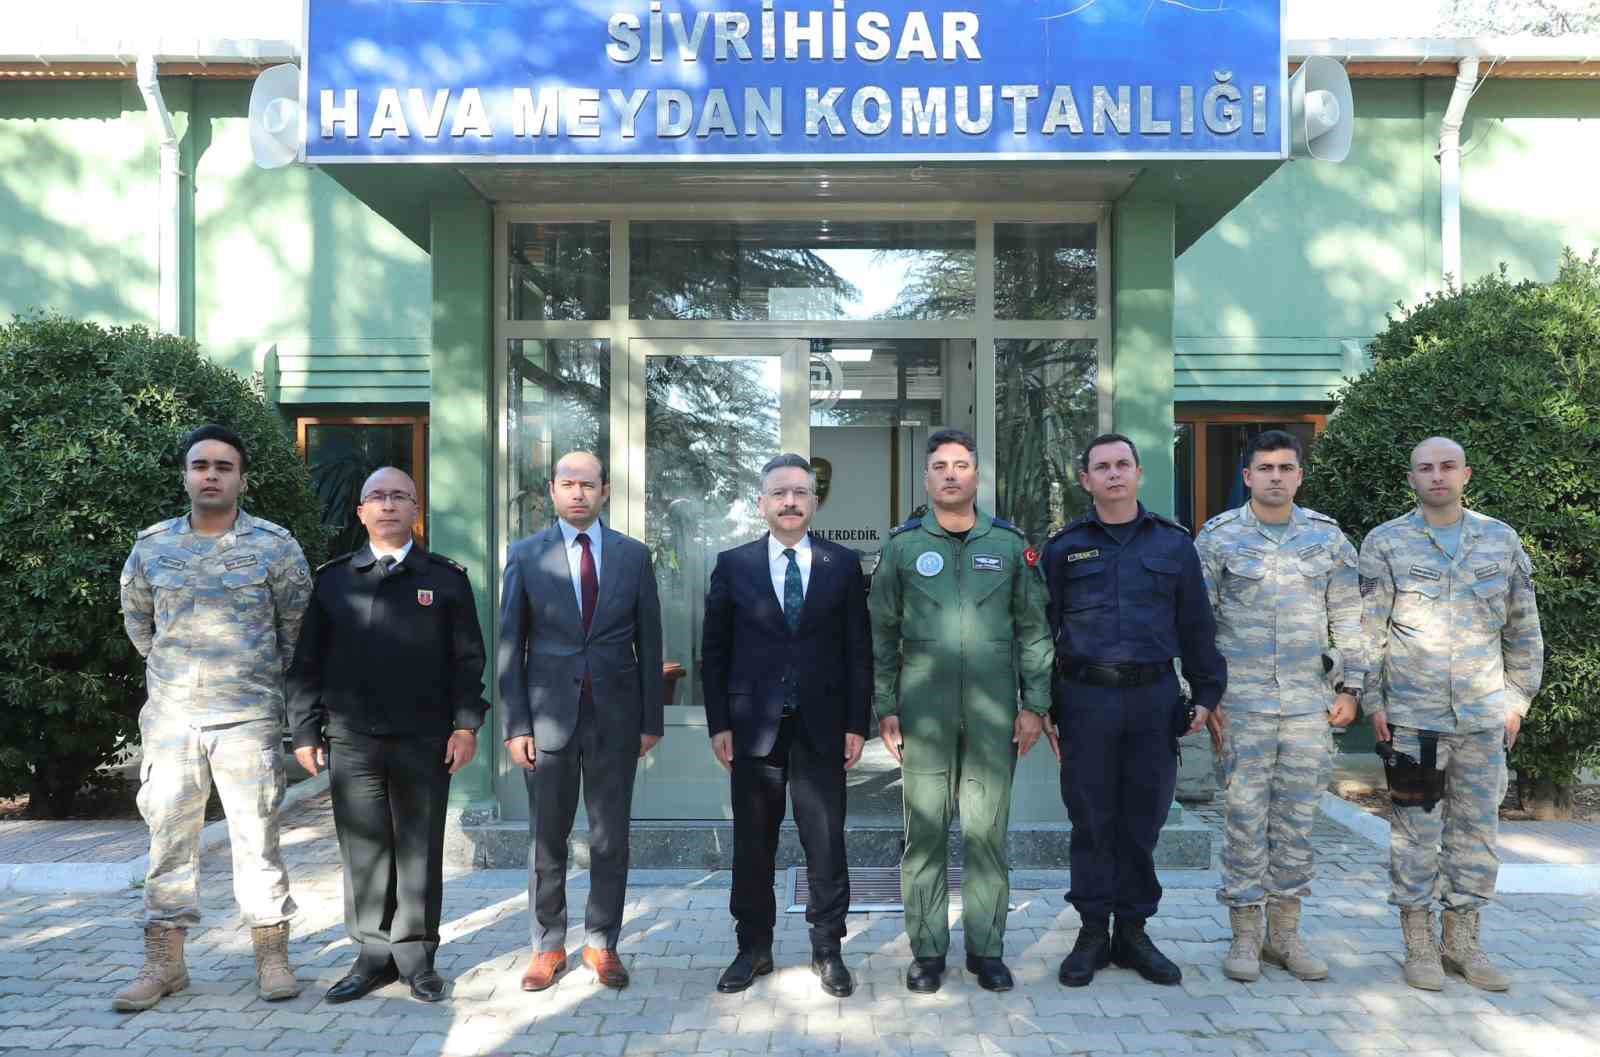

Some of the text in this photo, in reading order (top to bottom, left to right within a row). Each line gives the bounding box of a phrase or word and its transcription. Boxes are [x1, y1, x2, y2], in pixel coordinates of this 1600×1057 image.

[606, 0, 982, 61] SİVRİHİSAR
[320, 71, 1267, 138] HAVA MEYDAN KOMUTANLIĞI
